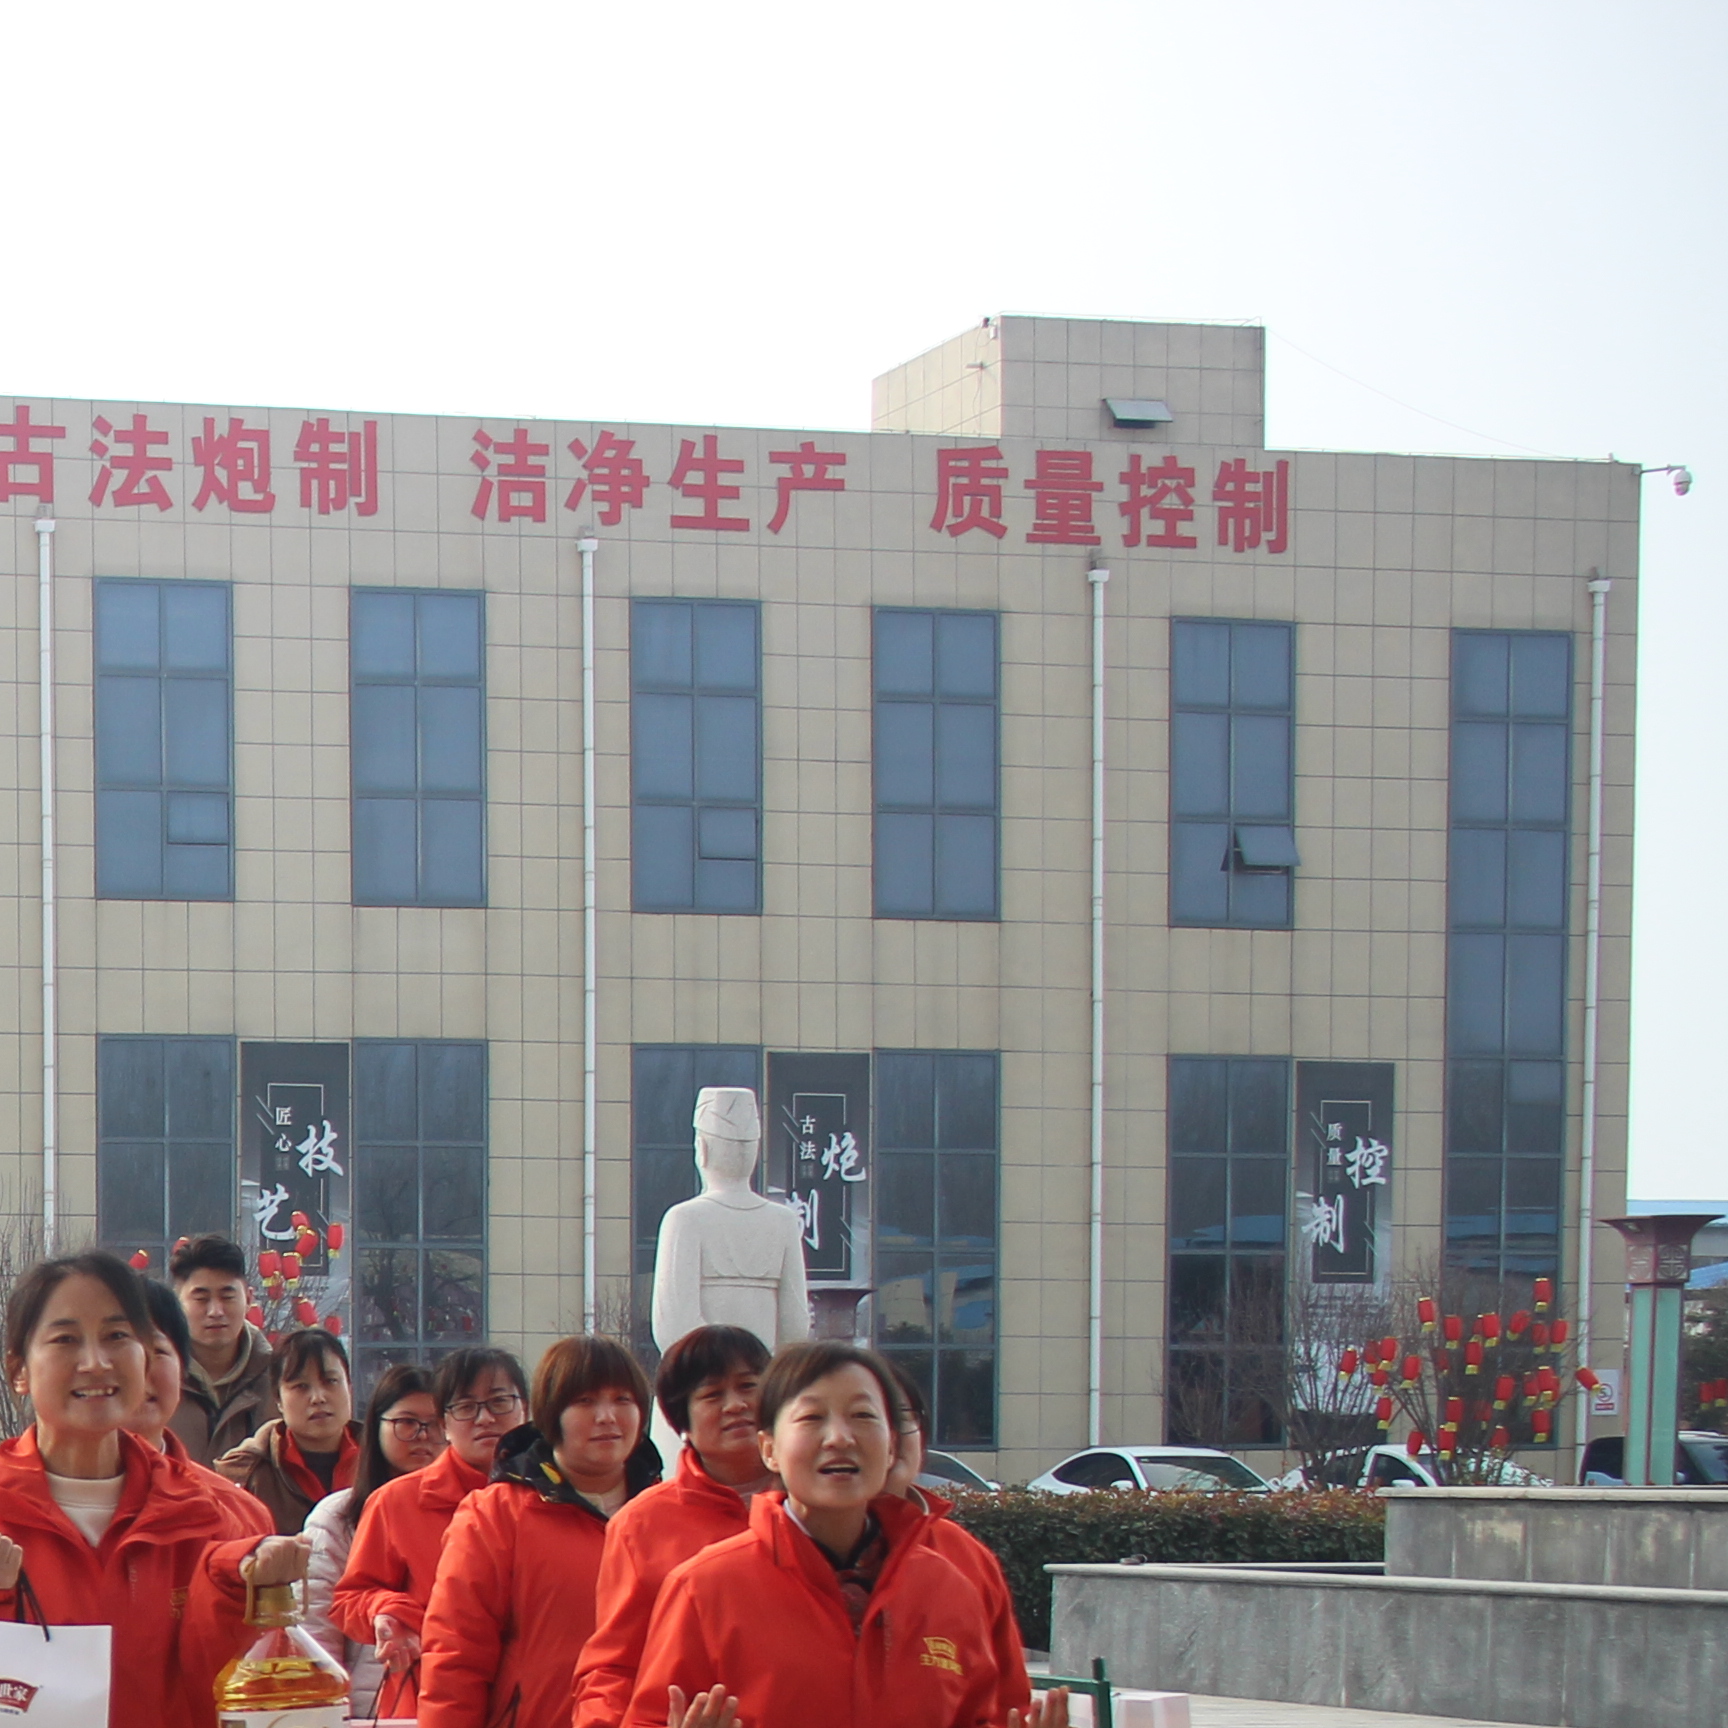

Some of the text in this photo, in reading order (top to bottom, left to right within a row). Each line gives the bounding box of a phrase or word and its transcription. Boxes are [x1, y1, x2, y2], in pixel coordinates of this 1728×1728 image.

[470, 427, 848, 534] 洁净生产
[930, 444, 1291, 555] 质量控制
[274, 1106, 293, 1152] 匠心
[799, 1115, 817, 1160] 古法
[1326, 1122, 1343, 1166] 质量
